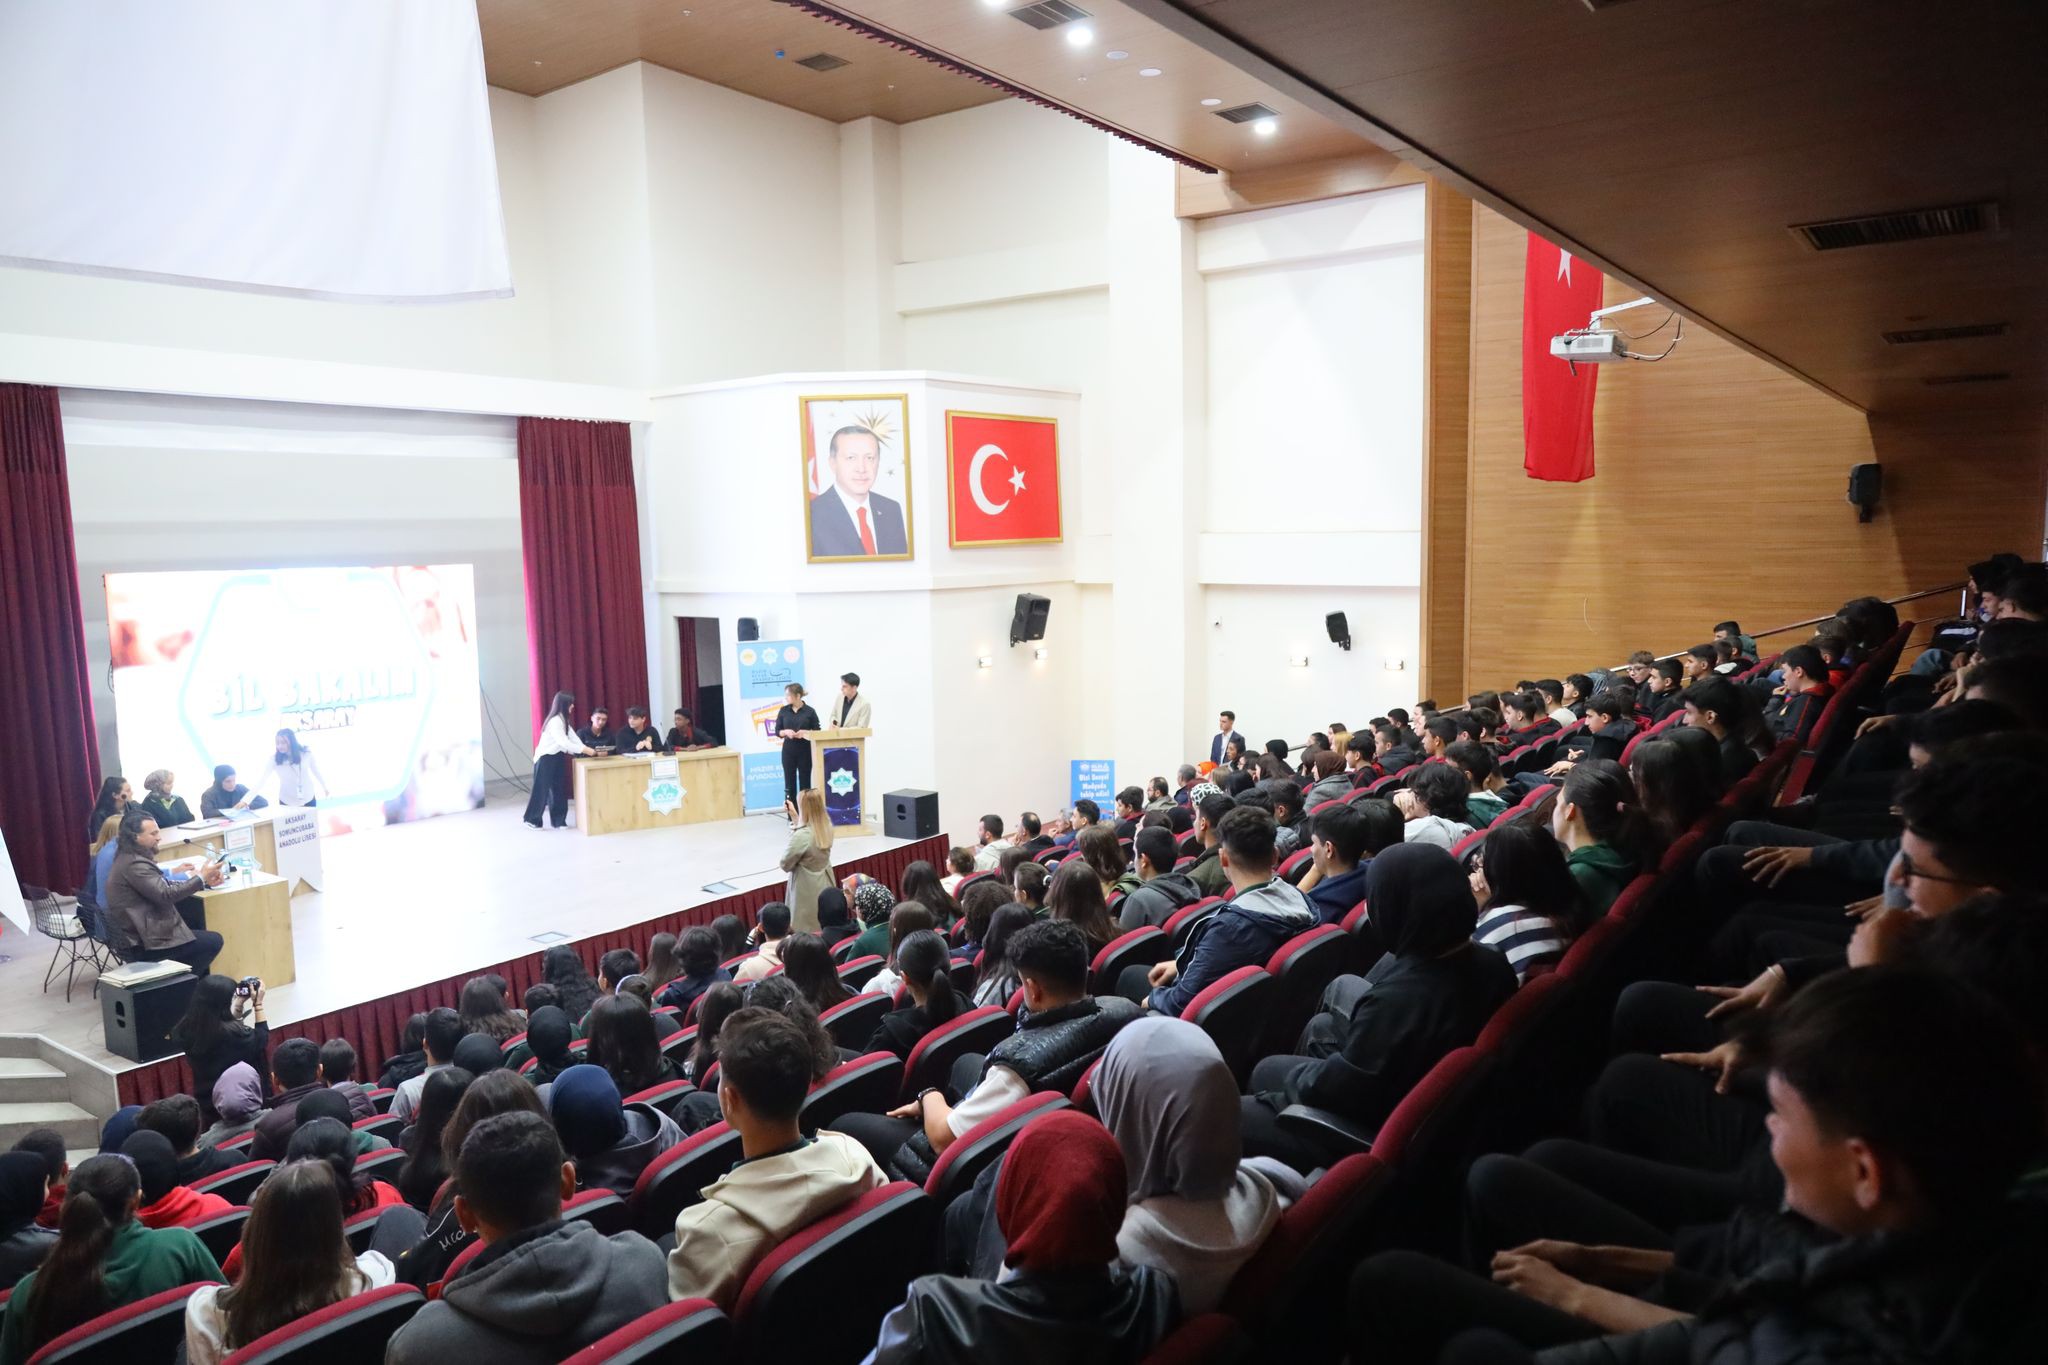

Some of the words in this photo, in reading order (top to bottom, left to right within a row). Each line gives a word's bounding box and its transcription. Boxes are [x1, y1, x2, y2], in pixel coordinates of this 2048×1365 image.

[1080, 791, 1094, 799] takip
[285, 813, 306, 825] AKSARAY
[279, 822, 315, 838] SOMUNCUBABA
[279, 836, 301, 849] ANADOLU
